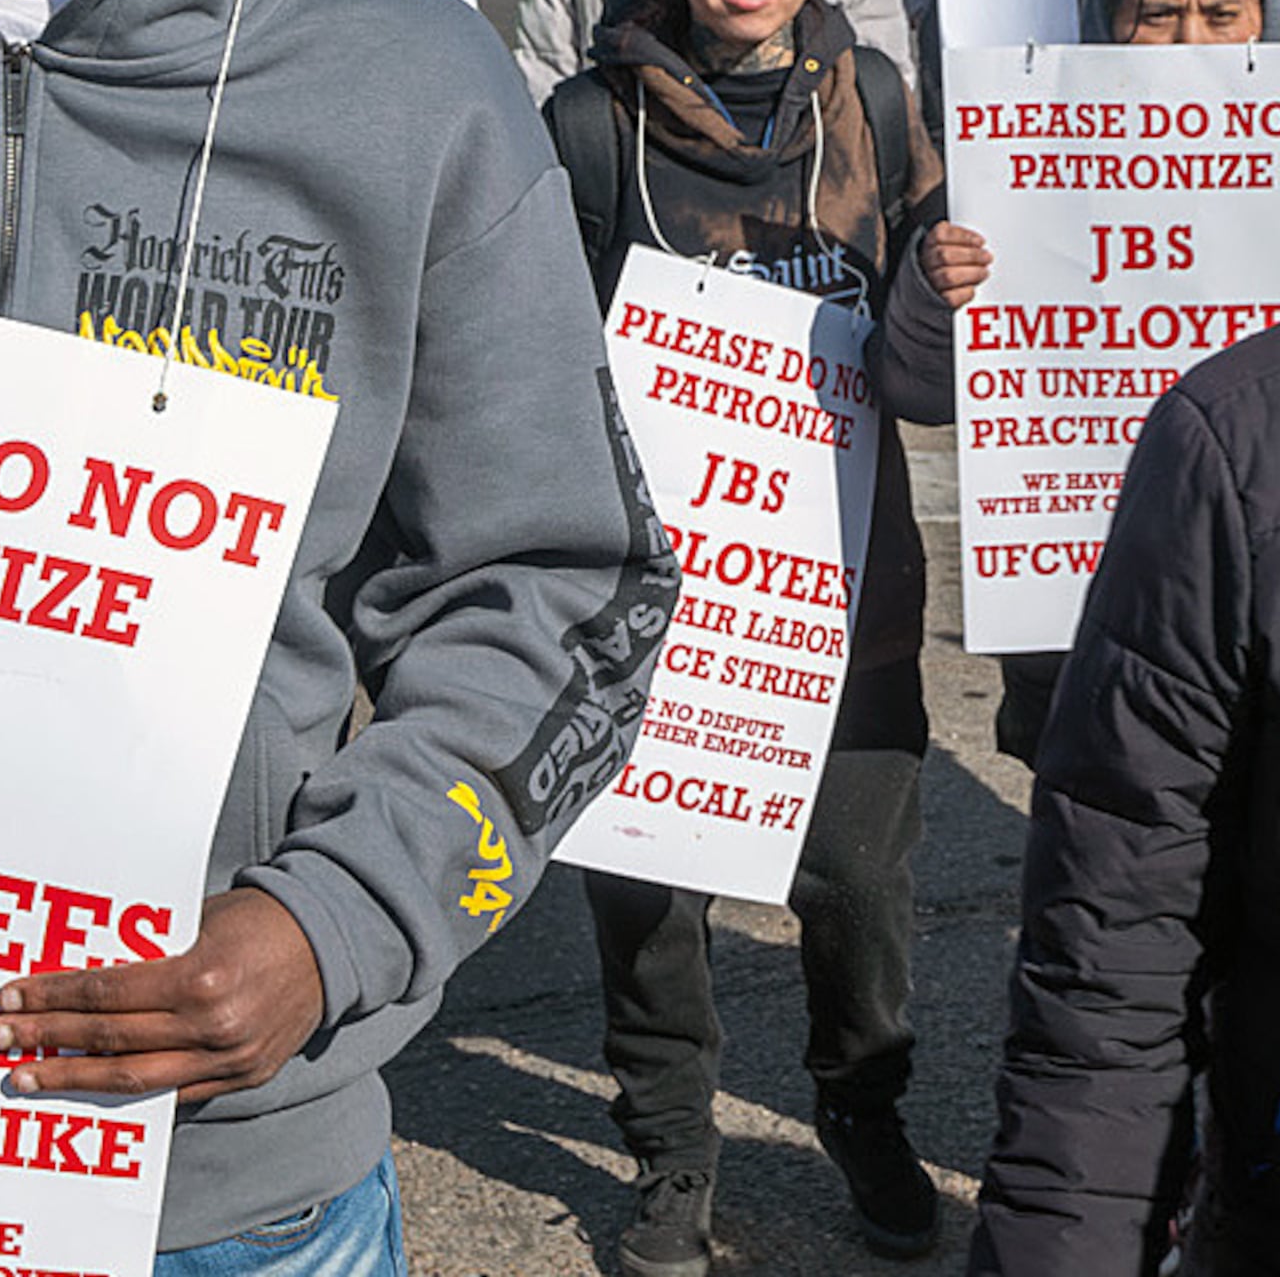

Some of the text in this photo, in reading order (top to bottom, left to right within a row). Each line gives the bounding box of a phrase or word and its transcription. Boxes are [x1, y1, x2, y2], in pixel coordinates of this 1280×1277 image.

[957, 101, 1127, 141] PLEASE
[1139, 103, 1209, 140] DO
[1010, 152, 1274, 191] PATRONIZE
[1091, 224, 1195, 283] JBS
[238, 296, 335, 374] TOUR
[615, 302, 876, 409] PLEASE DO NO
[646, 363, 855, 451] PATRONIZE
[967, 369, 1026, 401] ON
[690, 451, 790, 514] JBS
[977, 497, 1042, 516] WITH
[1047, 495, 1095, 513] ANY
[1023, 473, 1060, 491] WE
[68, 457, 286, 570] NOT
[973, 540, 1105, 578] UFCW
[742, 610, 845, 659] LABOR
[719, 655, 836, 705] STRIKE
[658, 699, 695, 723] NO
[697, 708, 785, 742] DISPUTE
[702, 732, 812, 771] EMPLOYER
[613, 762, 805, 831] LOCAL #7
